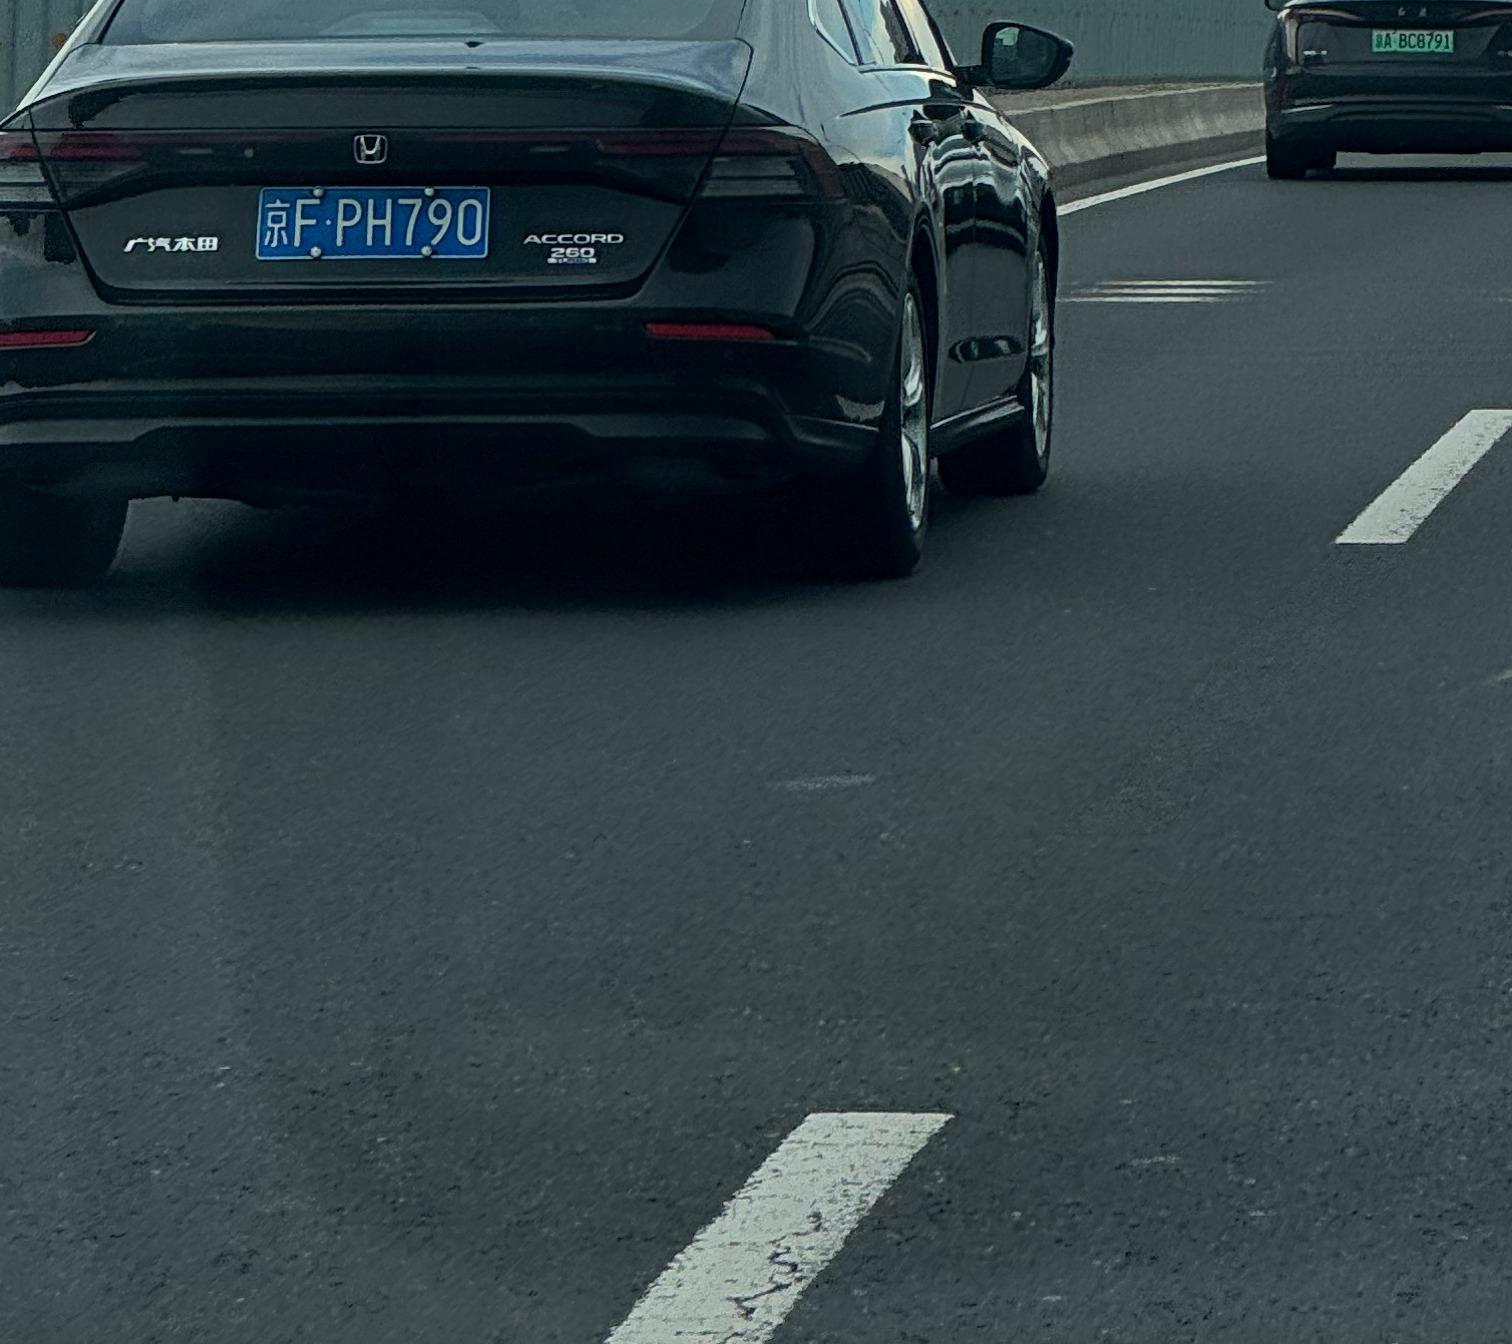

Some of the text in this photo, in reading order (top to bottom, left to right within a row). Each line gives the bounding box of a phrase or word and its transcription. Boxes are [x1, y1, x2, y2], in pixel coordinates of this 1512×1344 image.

[523, 233, 624, 244] ACCORD
[123, 236, 219, 253] 广汽本田
[550, 247, 595, 258] 260
